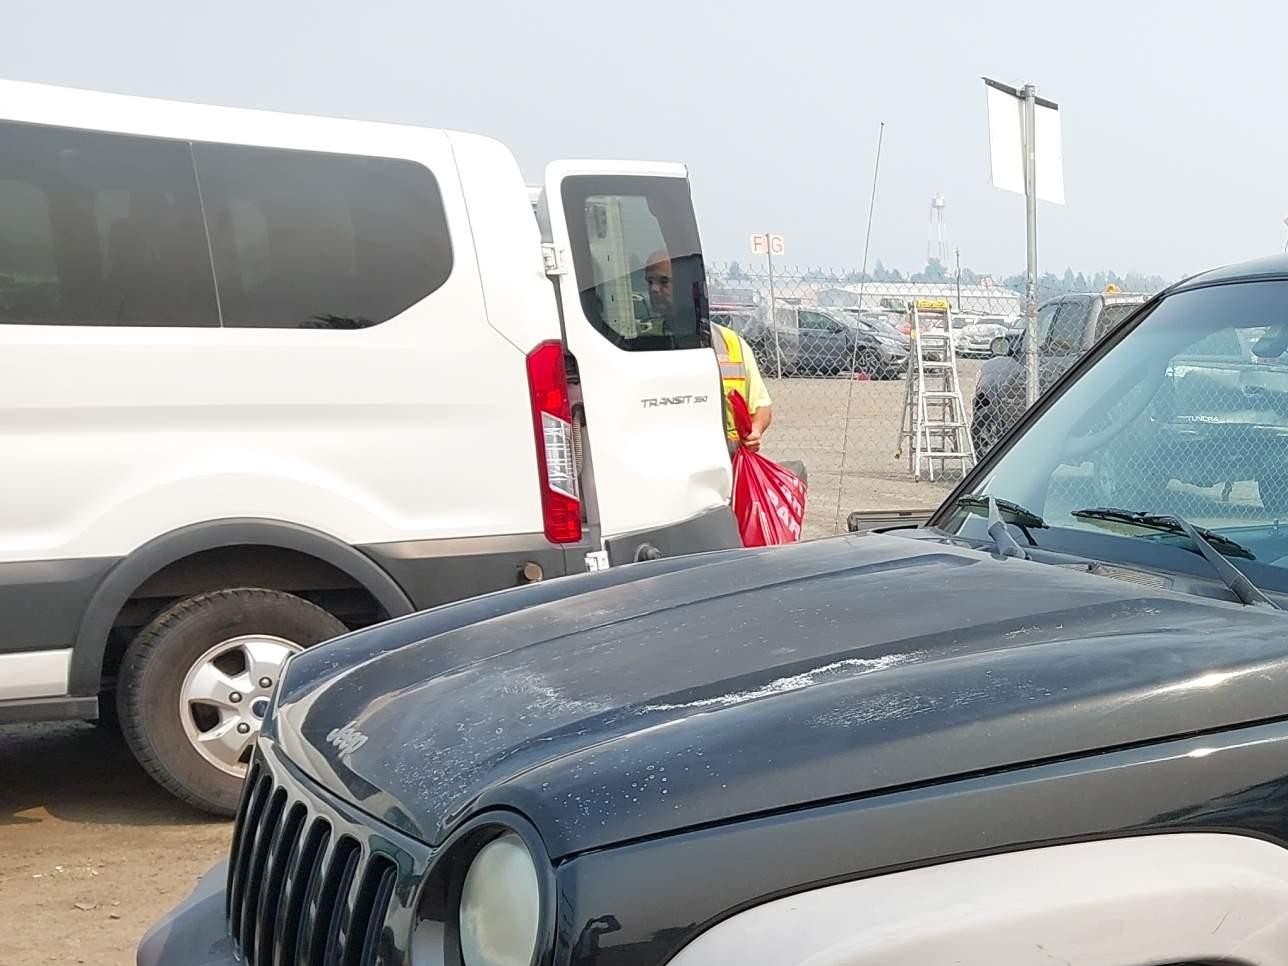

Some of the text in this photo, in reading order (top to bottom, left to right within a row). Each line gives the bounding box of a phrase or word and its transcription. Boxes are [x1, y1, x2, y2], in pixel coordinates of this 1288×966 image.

[753, 235, 783, 253] F G
[640, 395, 692, 408] TRANSIT
[326, 720, 369, 759] Jeep
